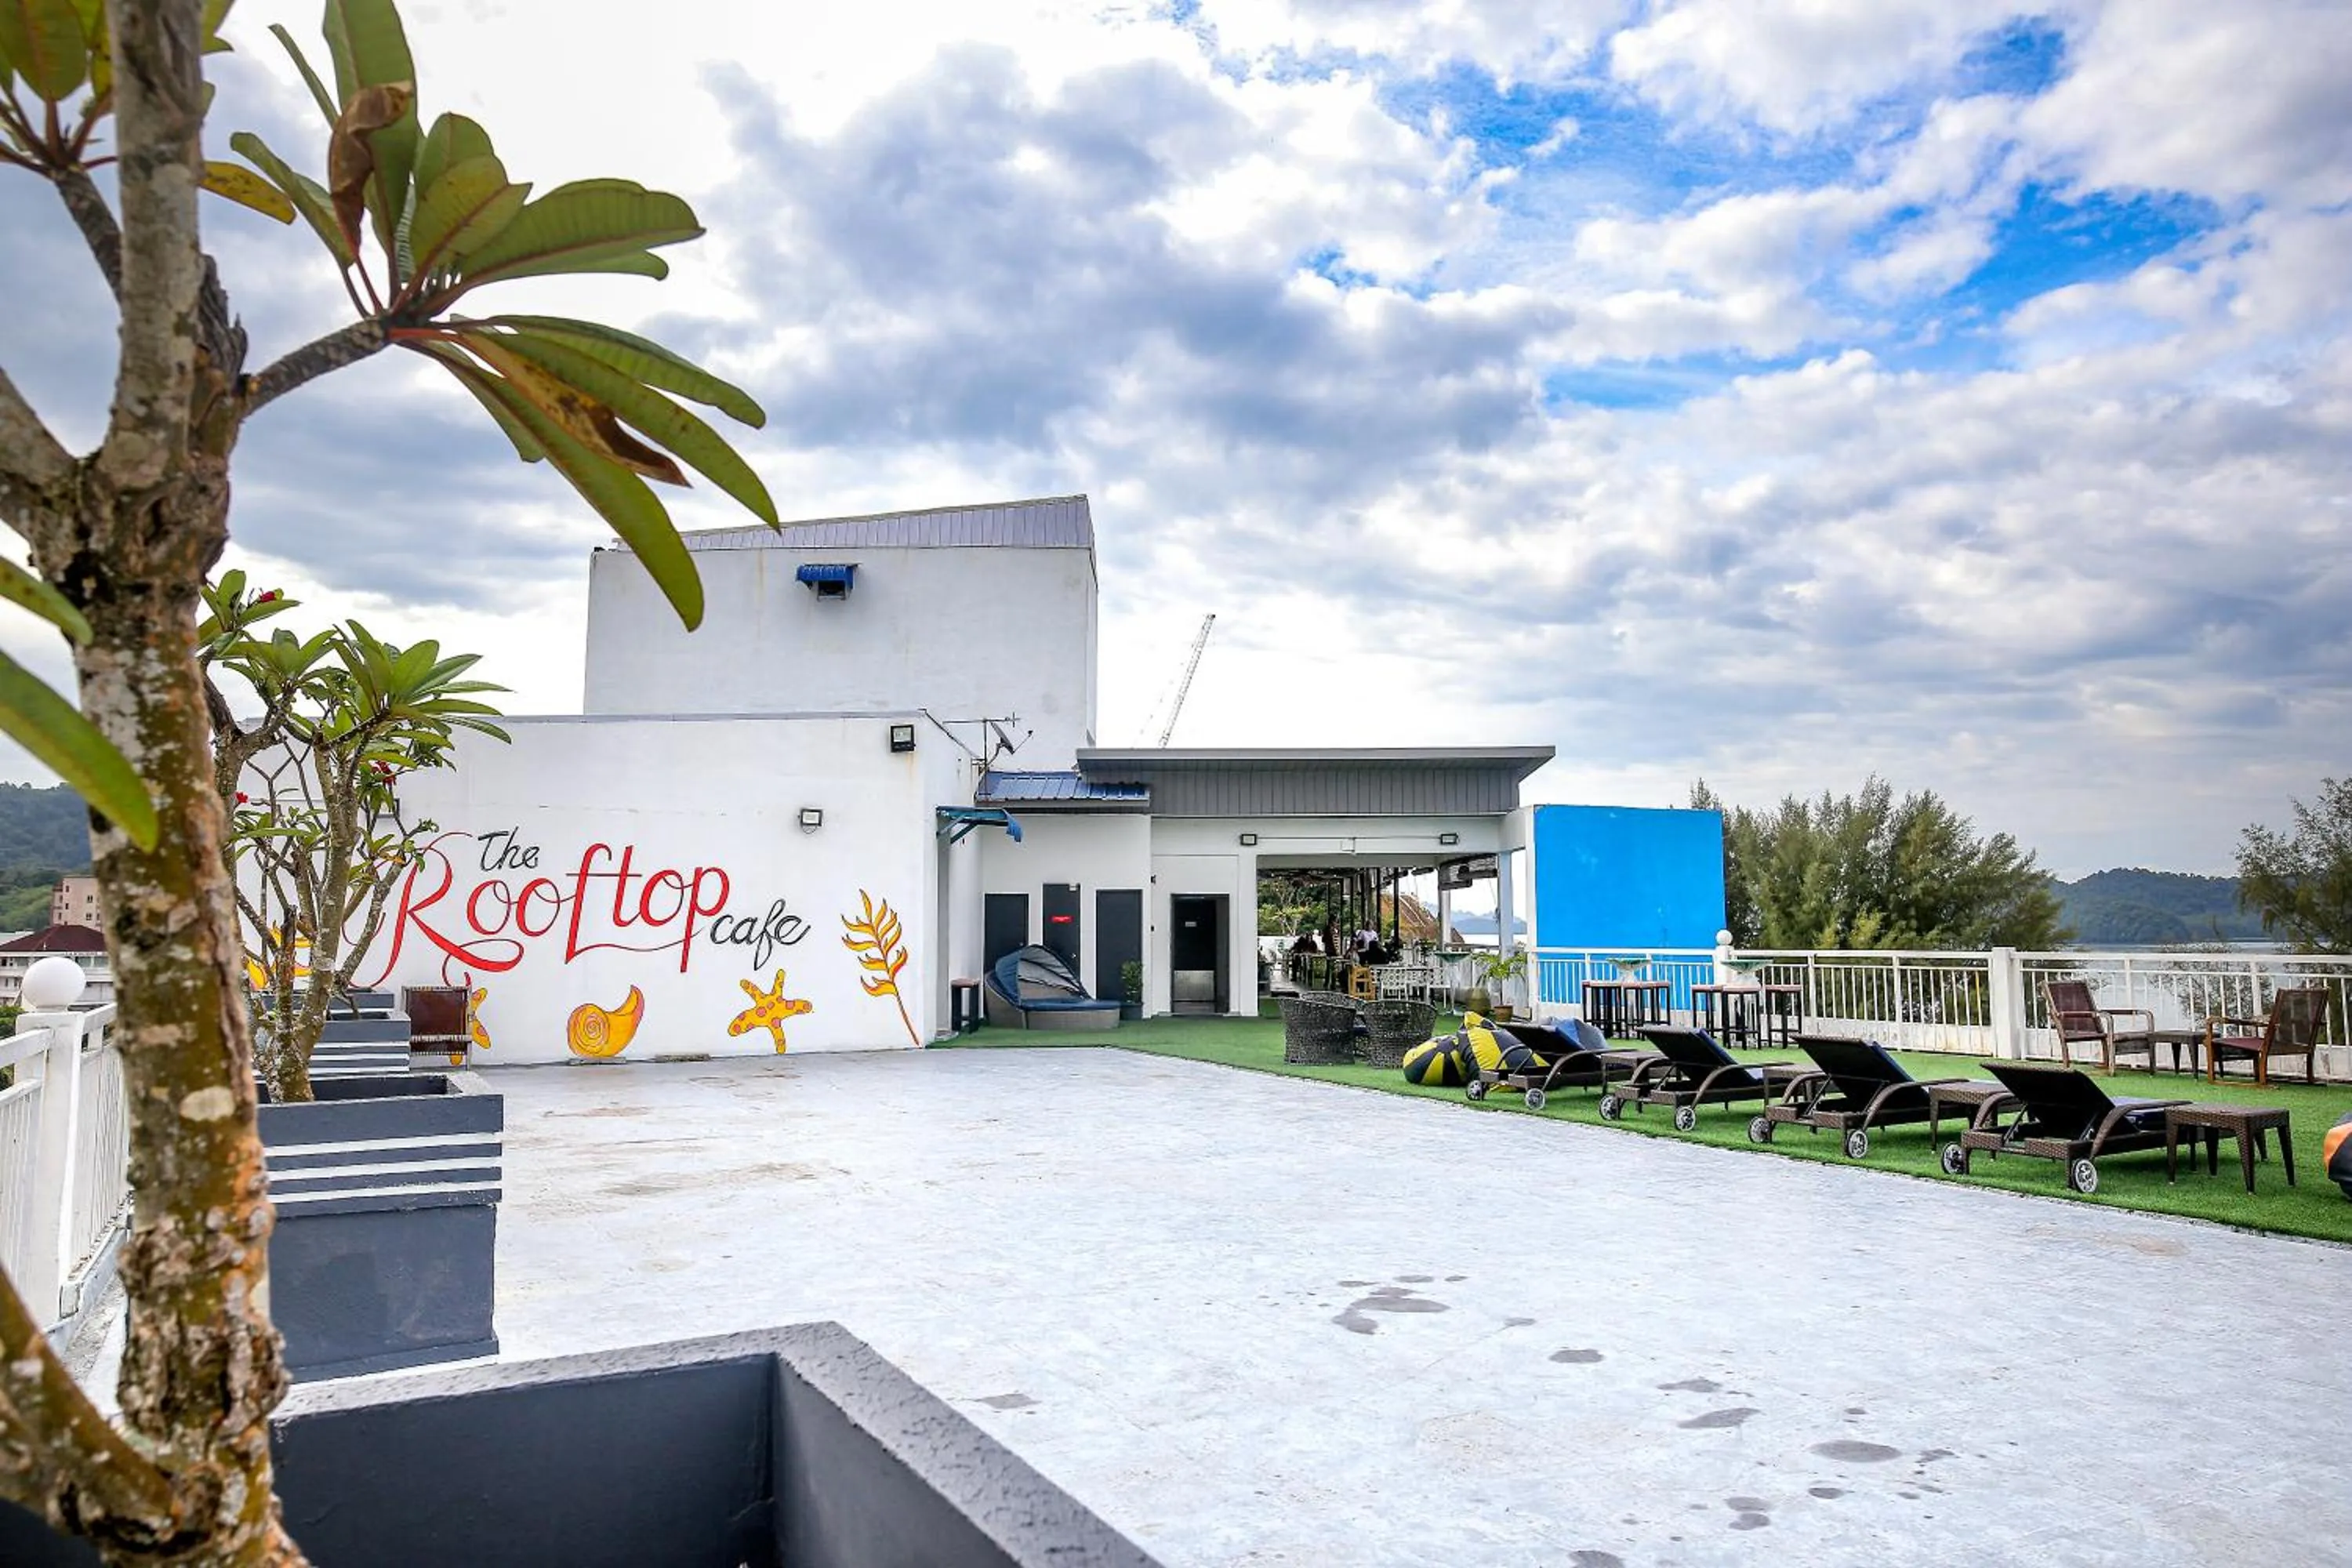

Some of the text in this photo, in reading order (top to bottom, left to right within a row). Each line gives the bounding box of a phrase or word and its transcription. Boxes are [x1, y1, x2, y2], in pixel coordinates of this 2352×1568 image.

[477, 826, 539, 871] The
[342, 832, 731, 988] Rooftop
[710, 898, 811, 971] cafe
